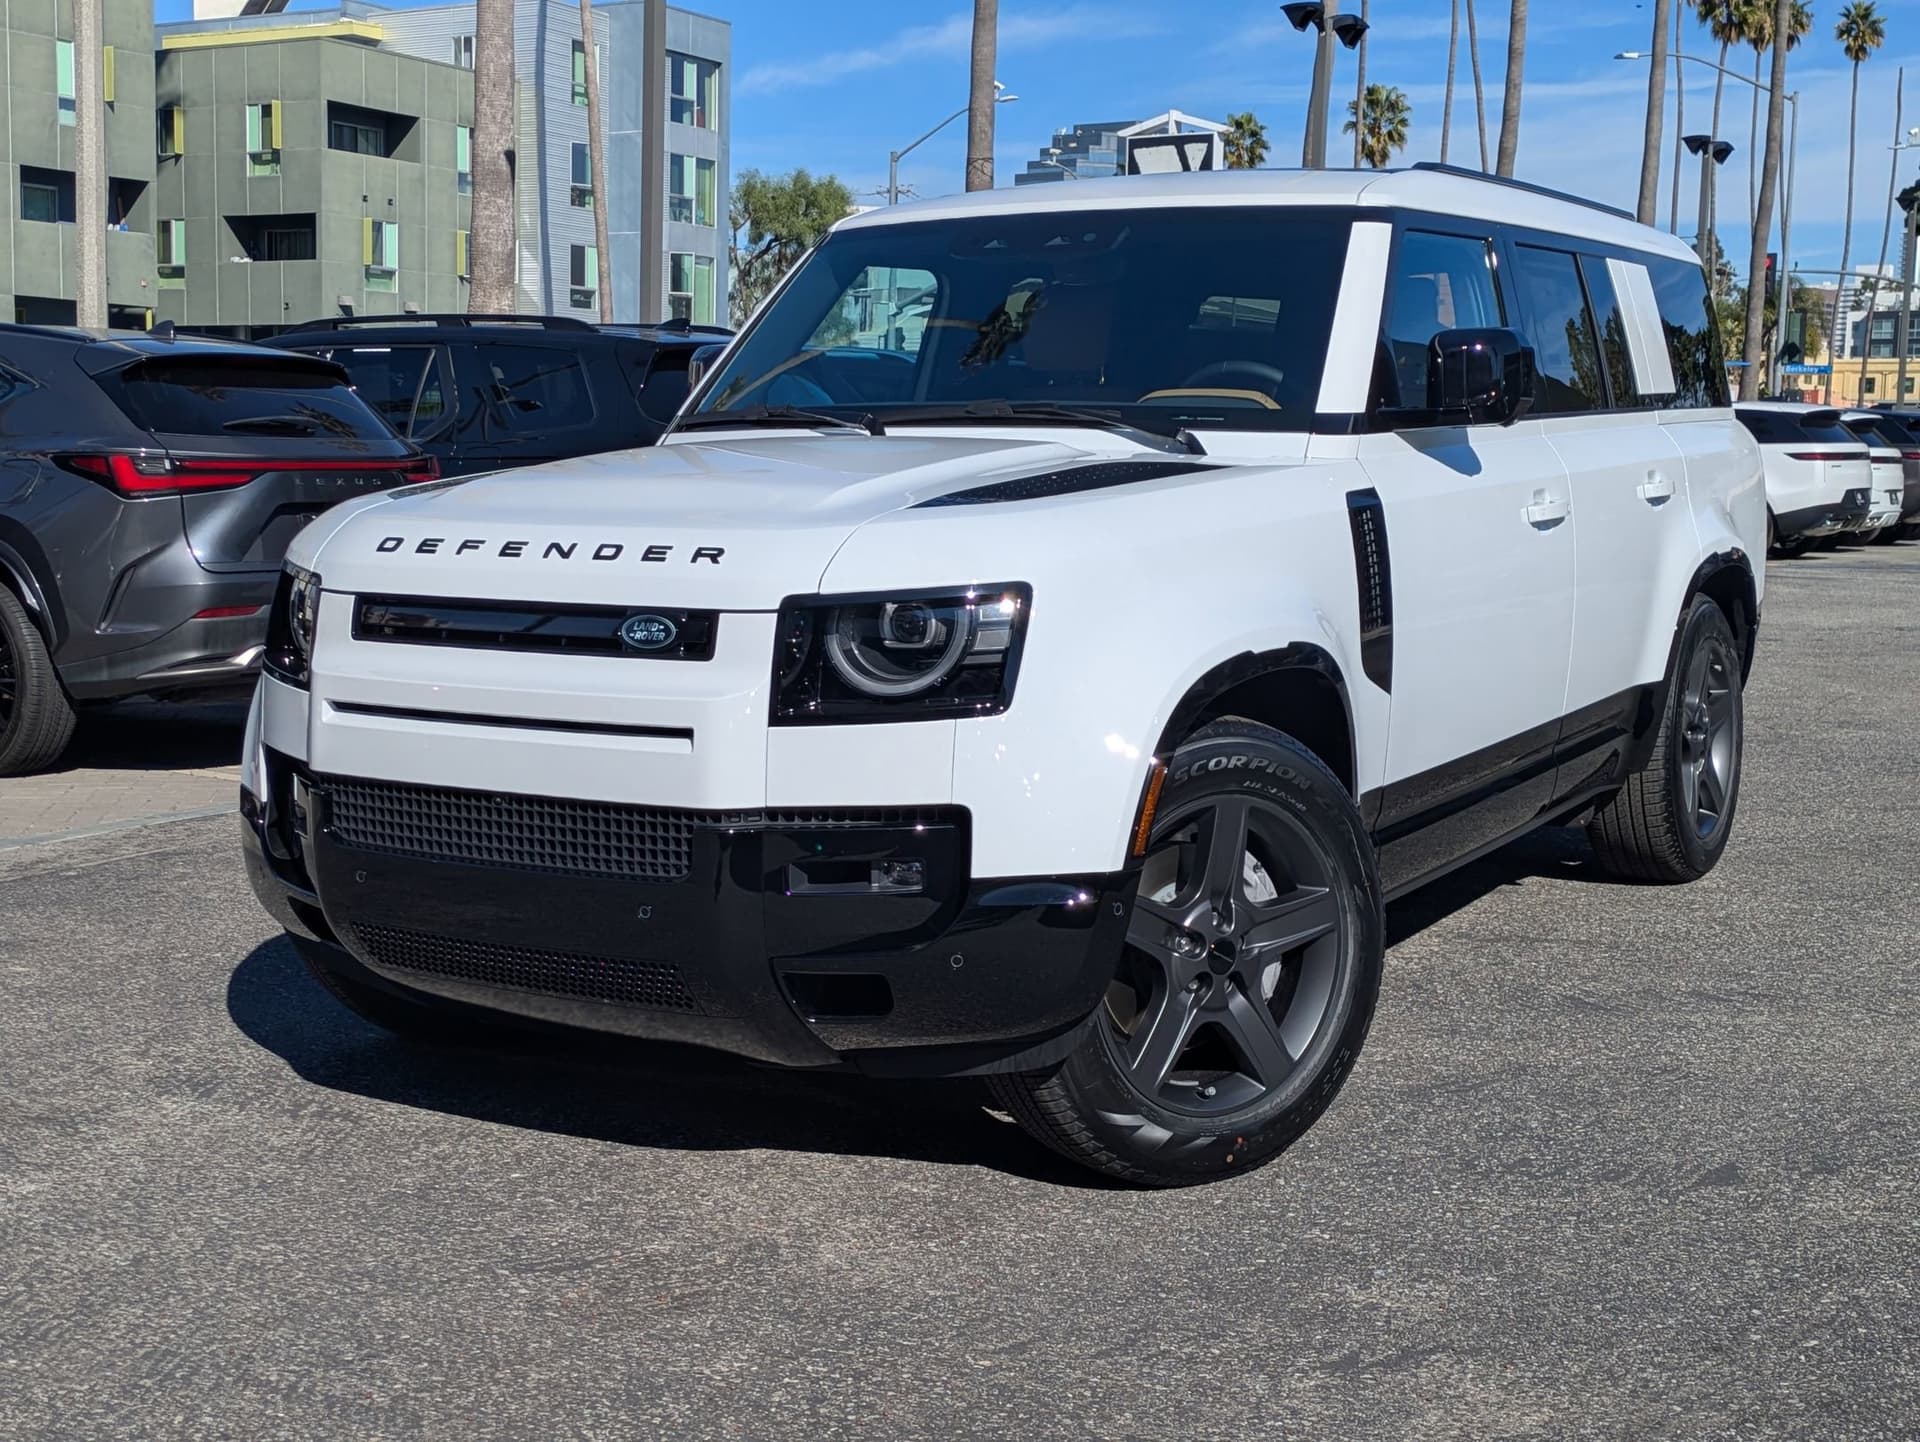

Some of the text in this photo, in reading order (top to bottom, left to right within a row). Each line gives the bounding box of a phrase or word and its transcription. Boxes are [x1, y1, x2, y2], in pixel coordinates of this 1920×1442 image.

[1785, 364, 1819, 374] Berkeley
[295, 477, 382, 486] LEXUS
[376, 537, 725, 564] DEFENDER
[1173, 755, 1312, 790] SCORPION
